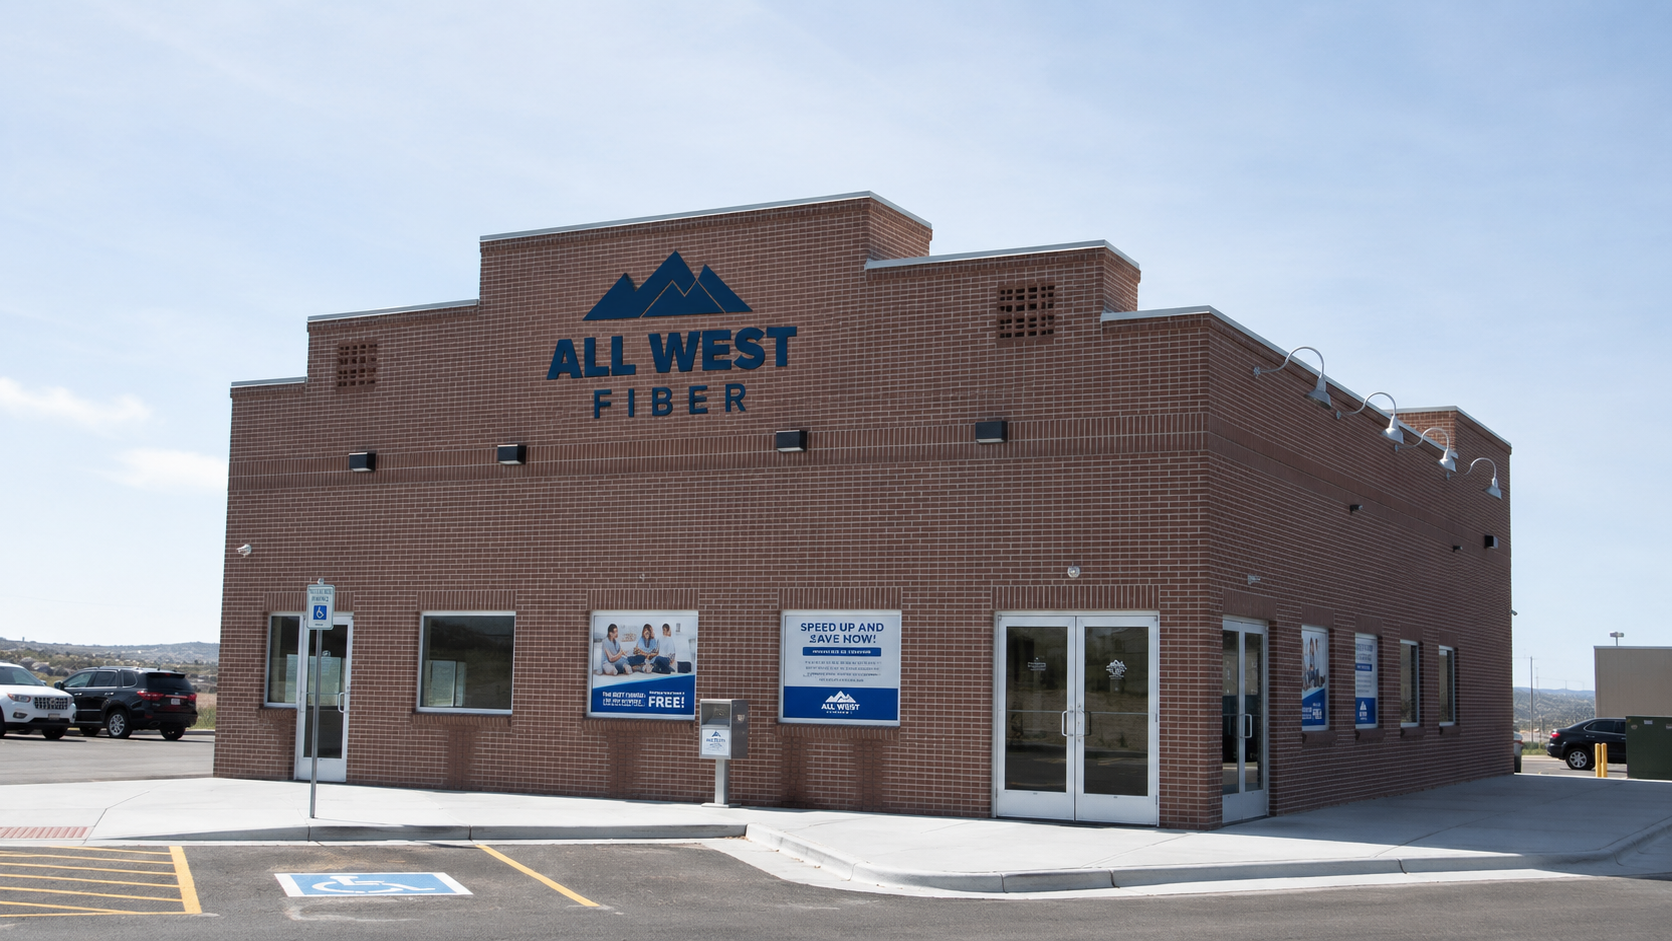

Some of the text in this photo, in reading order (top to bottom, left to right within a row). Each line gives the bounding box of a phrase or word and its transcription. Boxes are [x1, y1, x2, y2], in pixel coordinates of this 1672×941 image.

[546, 325, 798, 381] ALL WEST
[593, 382, 747, 420] FIBER
[800, 622, 884, 632] SPEED UP AND
[809, 634, 876, 644] SAVE NOW!
[648, 696, 685, 709] FREE!
[821, 703, 835, 711] ALL
